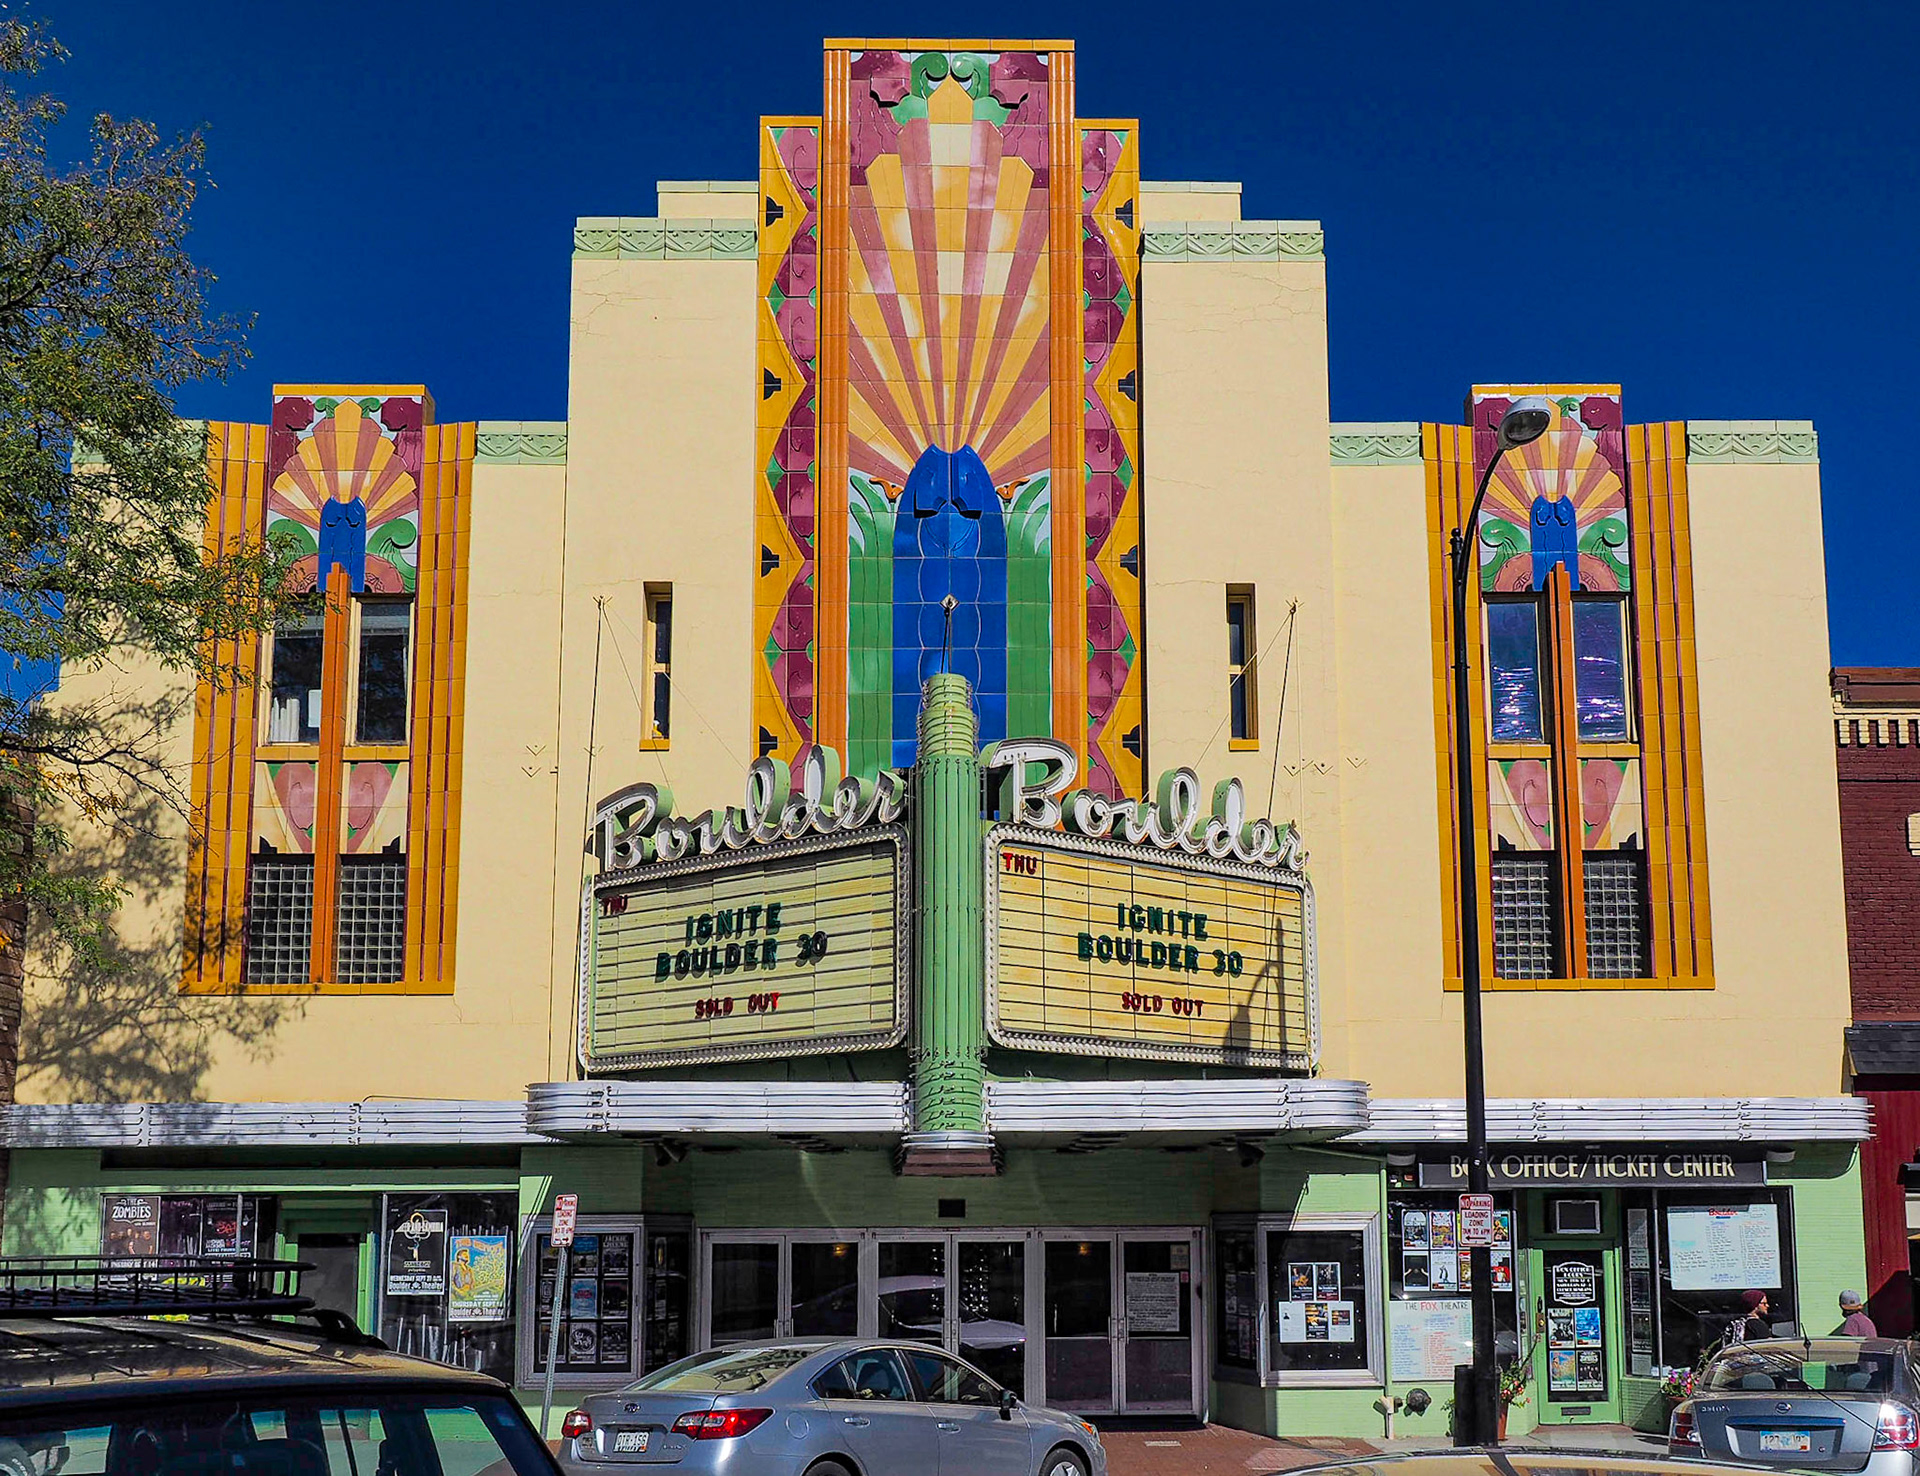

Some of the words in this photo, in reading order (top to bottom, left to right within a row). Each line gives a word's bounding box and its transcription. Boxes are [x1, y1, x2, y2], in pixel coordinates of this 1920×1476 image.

[588, 744, 906, 871] Boulder
[986, 737, 1309, 871] Boulder
[1003, 852, 1037, 875] THU
[602, 895, 628, 915] THU
[686, 903, 781, 946] IGNITE
[1117, 902, 1208, 941] IGNITE
[655, 938, 778, 983] BOULDER
[795, 931, 829, 967] 30
[1077, 932, 1199, 974] BOULDER
[1212, 949, 1243, 978] 30
[695, 997, 734, 1019] SOLD
[747, 992, 781, 1013] OUT
[1121, 991, 1163, 1013] SOLD
[1172, 997, 1204, 1017] OUT
[1450, 1155, 1496, 1178] BX
[1663, 1154, 1735, 1178] CENTER
[112, 1205, 152, 1219] ZOMBIES
[1460, 1198, 1470, 1208] NO
[1470, 1200, 1490, 1208] PARKING
[1464, 1211, 1489, 1219] LOADING
[1469, 1219, 1484, 1227] ZONE
[1405, 1302, 1418, 1311] THE
[1420, 1302, 1438, 1311] FOX
[1441, 1301, 1469, 1311] THEATRE
